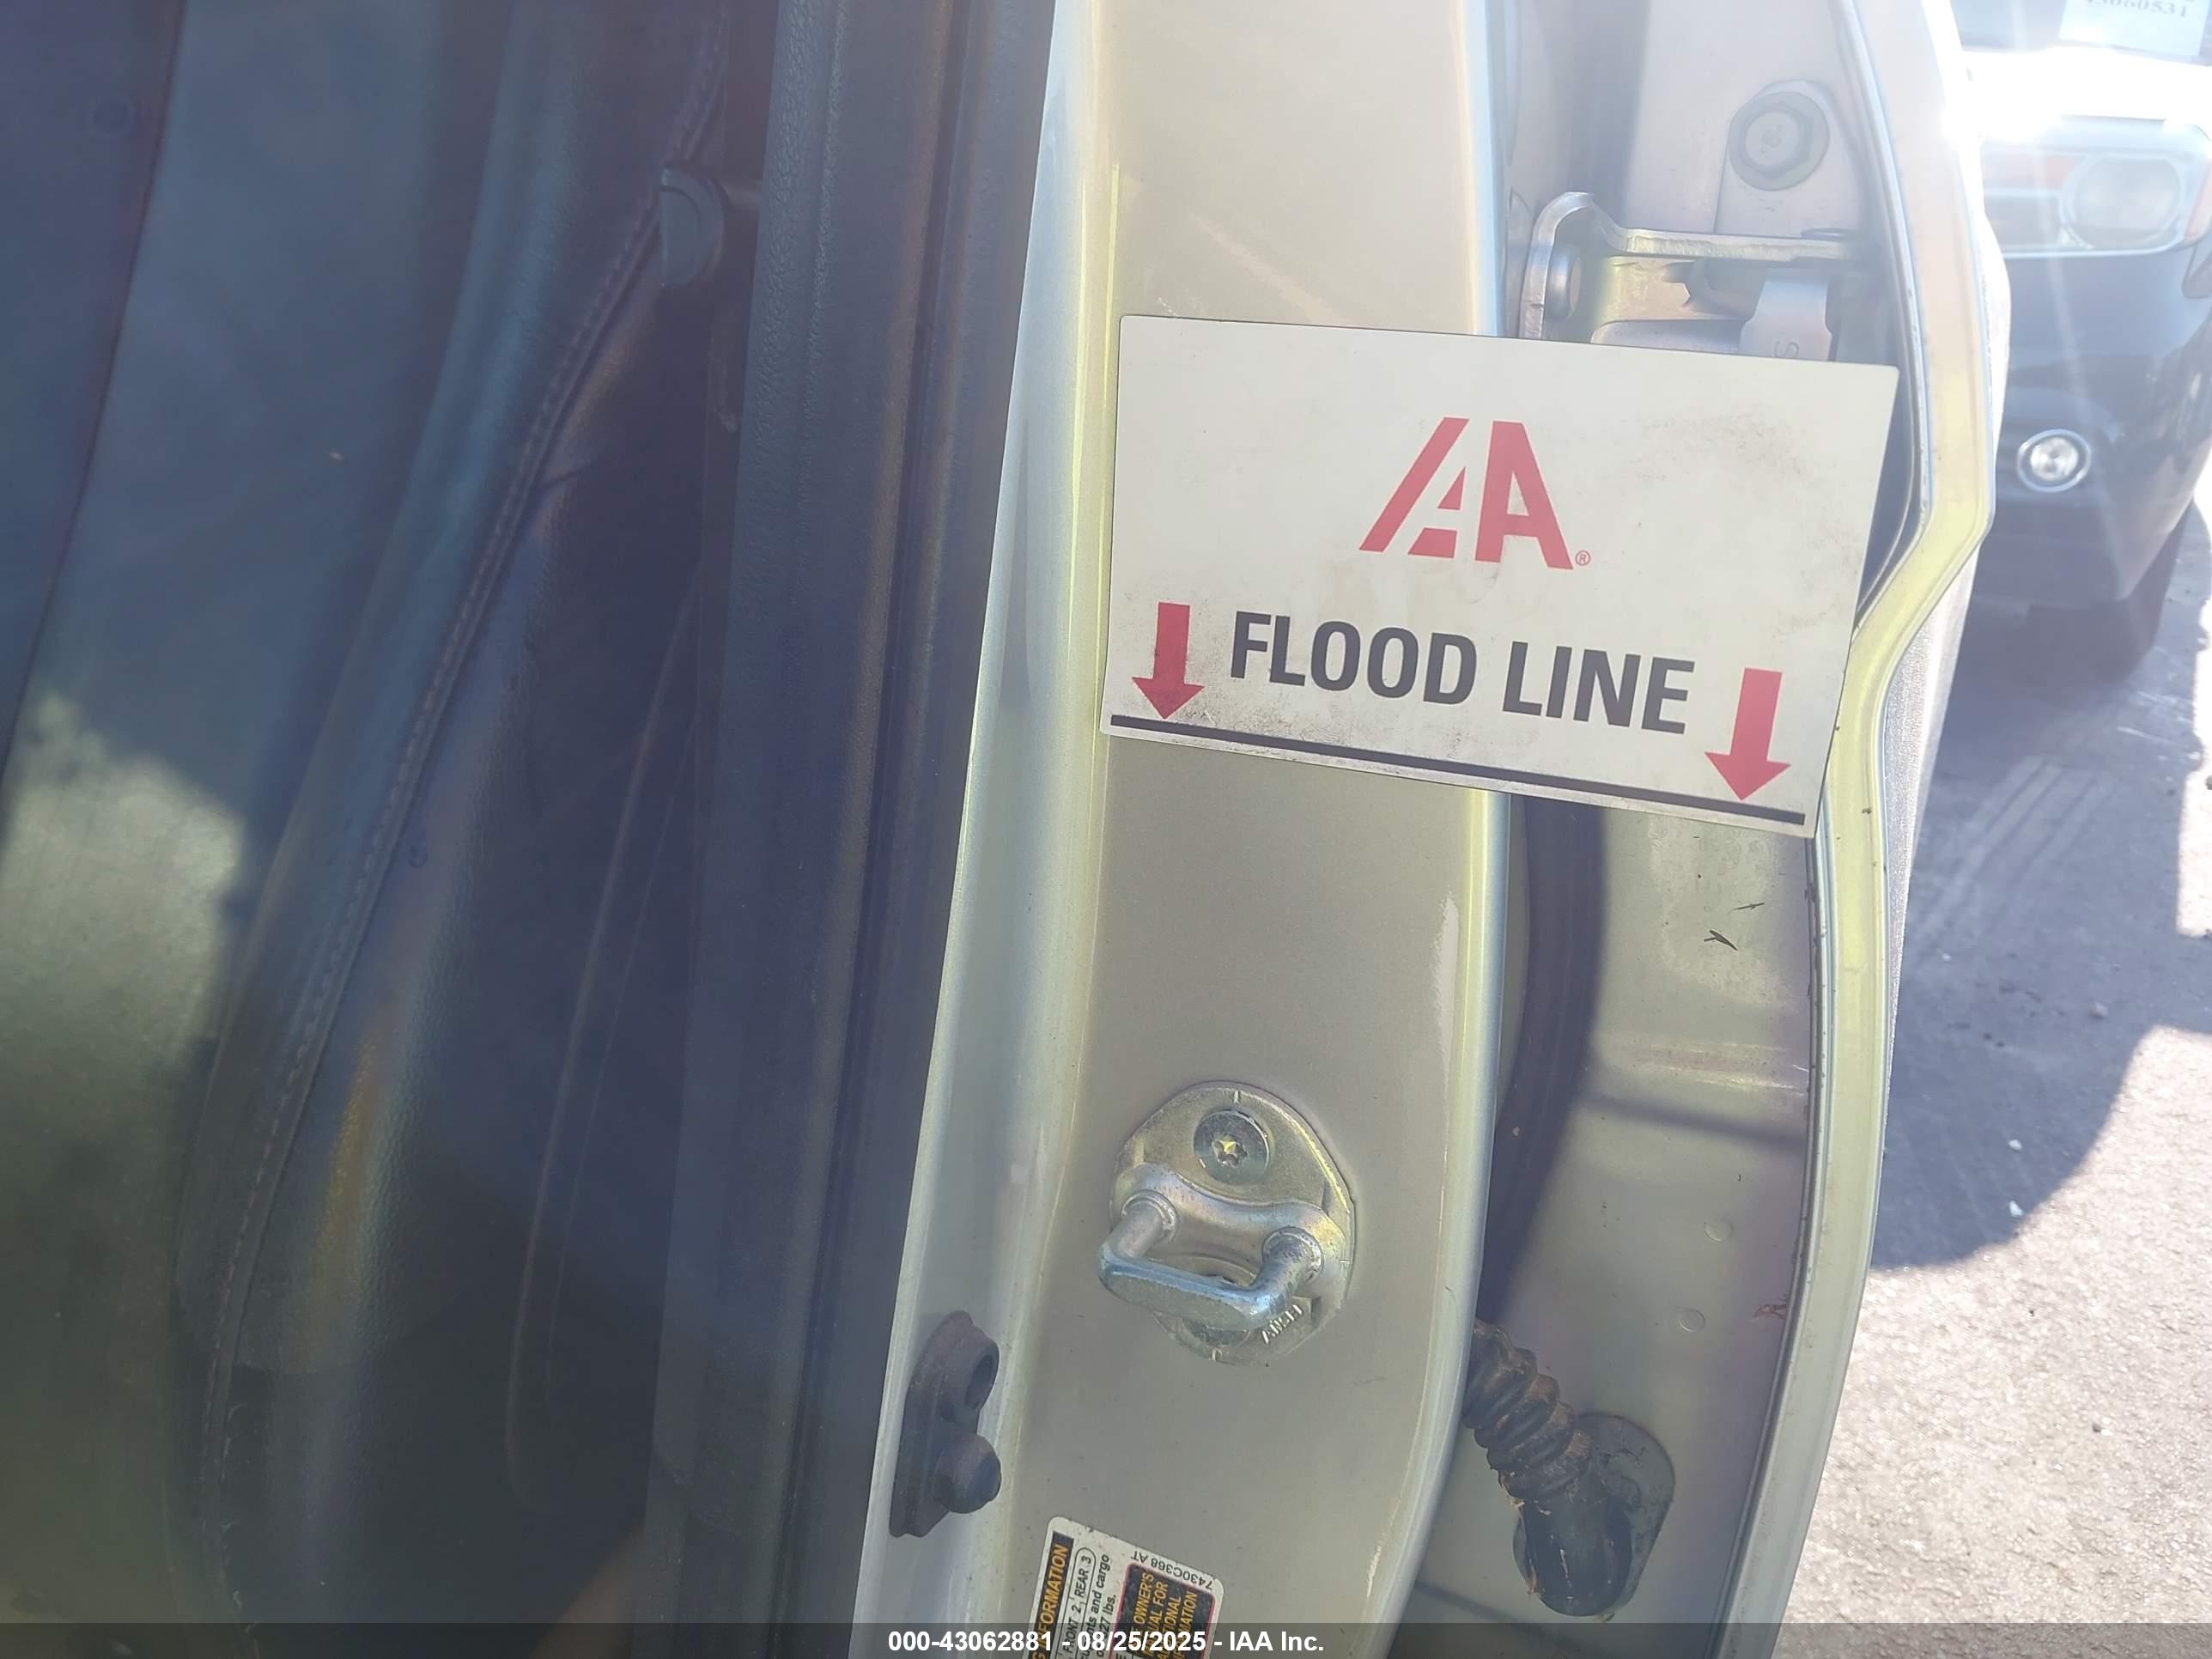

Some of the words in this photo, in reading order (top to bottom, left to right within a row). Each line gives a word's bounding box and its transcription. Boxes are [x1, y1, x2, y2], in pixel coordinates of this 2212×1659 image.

[1231, 611, 1477, 706] FLOOD
[1503, 641, 1694, 735] LINE
[1081, 1555, 1091, 1565] 3
[1130, 1550, 1149, 1564] AT
[1074, 1568, 1090, 1598] REAR
[1096, 1553, 1111, 1589] cargo
[1091, 1589, 1103, 1614] and
[1102, 1594, 1116, 1615] lbs.
[1133, 1572, 1154, 1624] OWNER'S
[1153, 1581, 1169, 1607] FOR
[1071, 1604, 1081, 1614] 2
